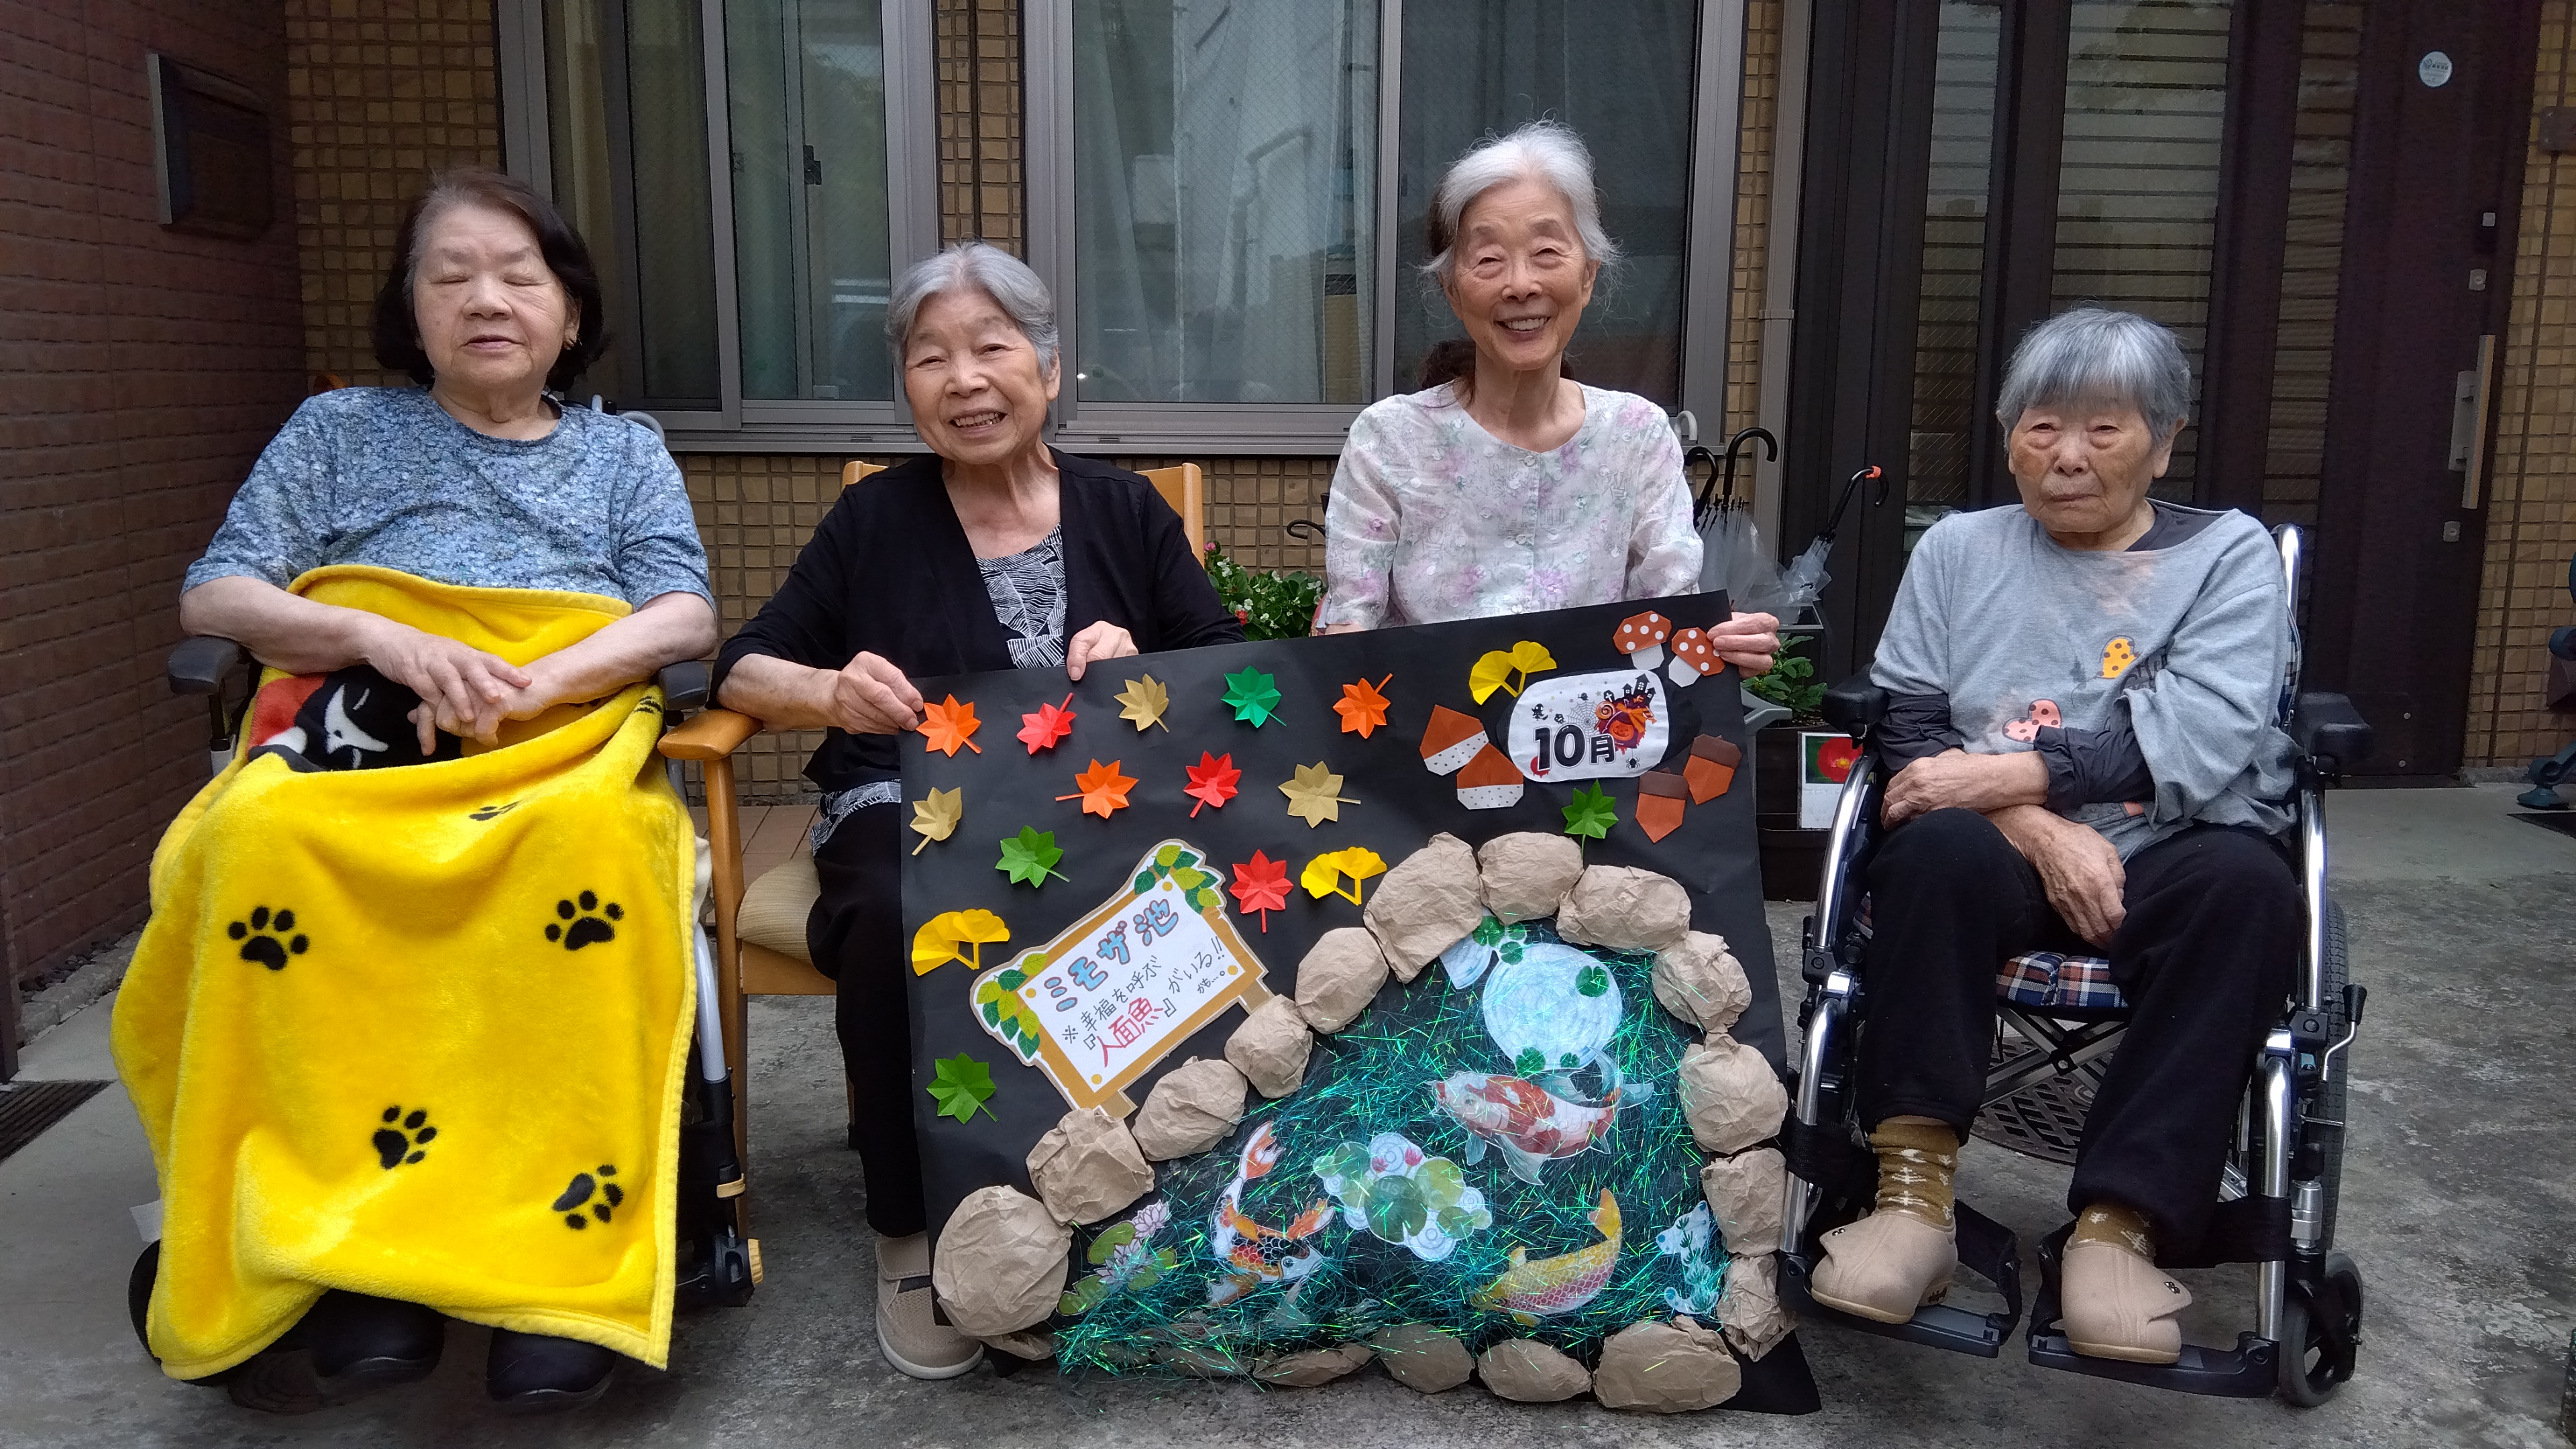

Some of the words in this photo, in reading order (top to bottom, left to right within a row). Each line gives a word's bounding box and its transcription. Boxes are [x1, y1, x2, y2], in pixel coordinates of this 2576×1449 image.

[1534, 724, 1615, 771] 10月
[1044, 898, 1179, 1012] ミモザ池
